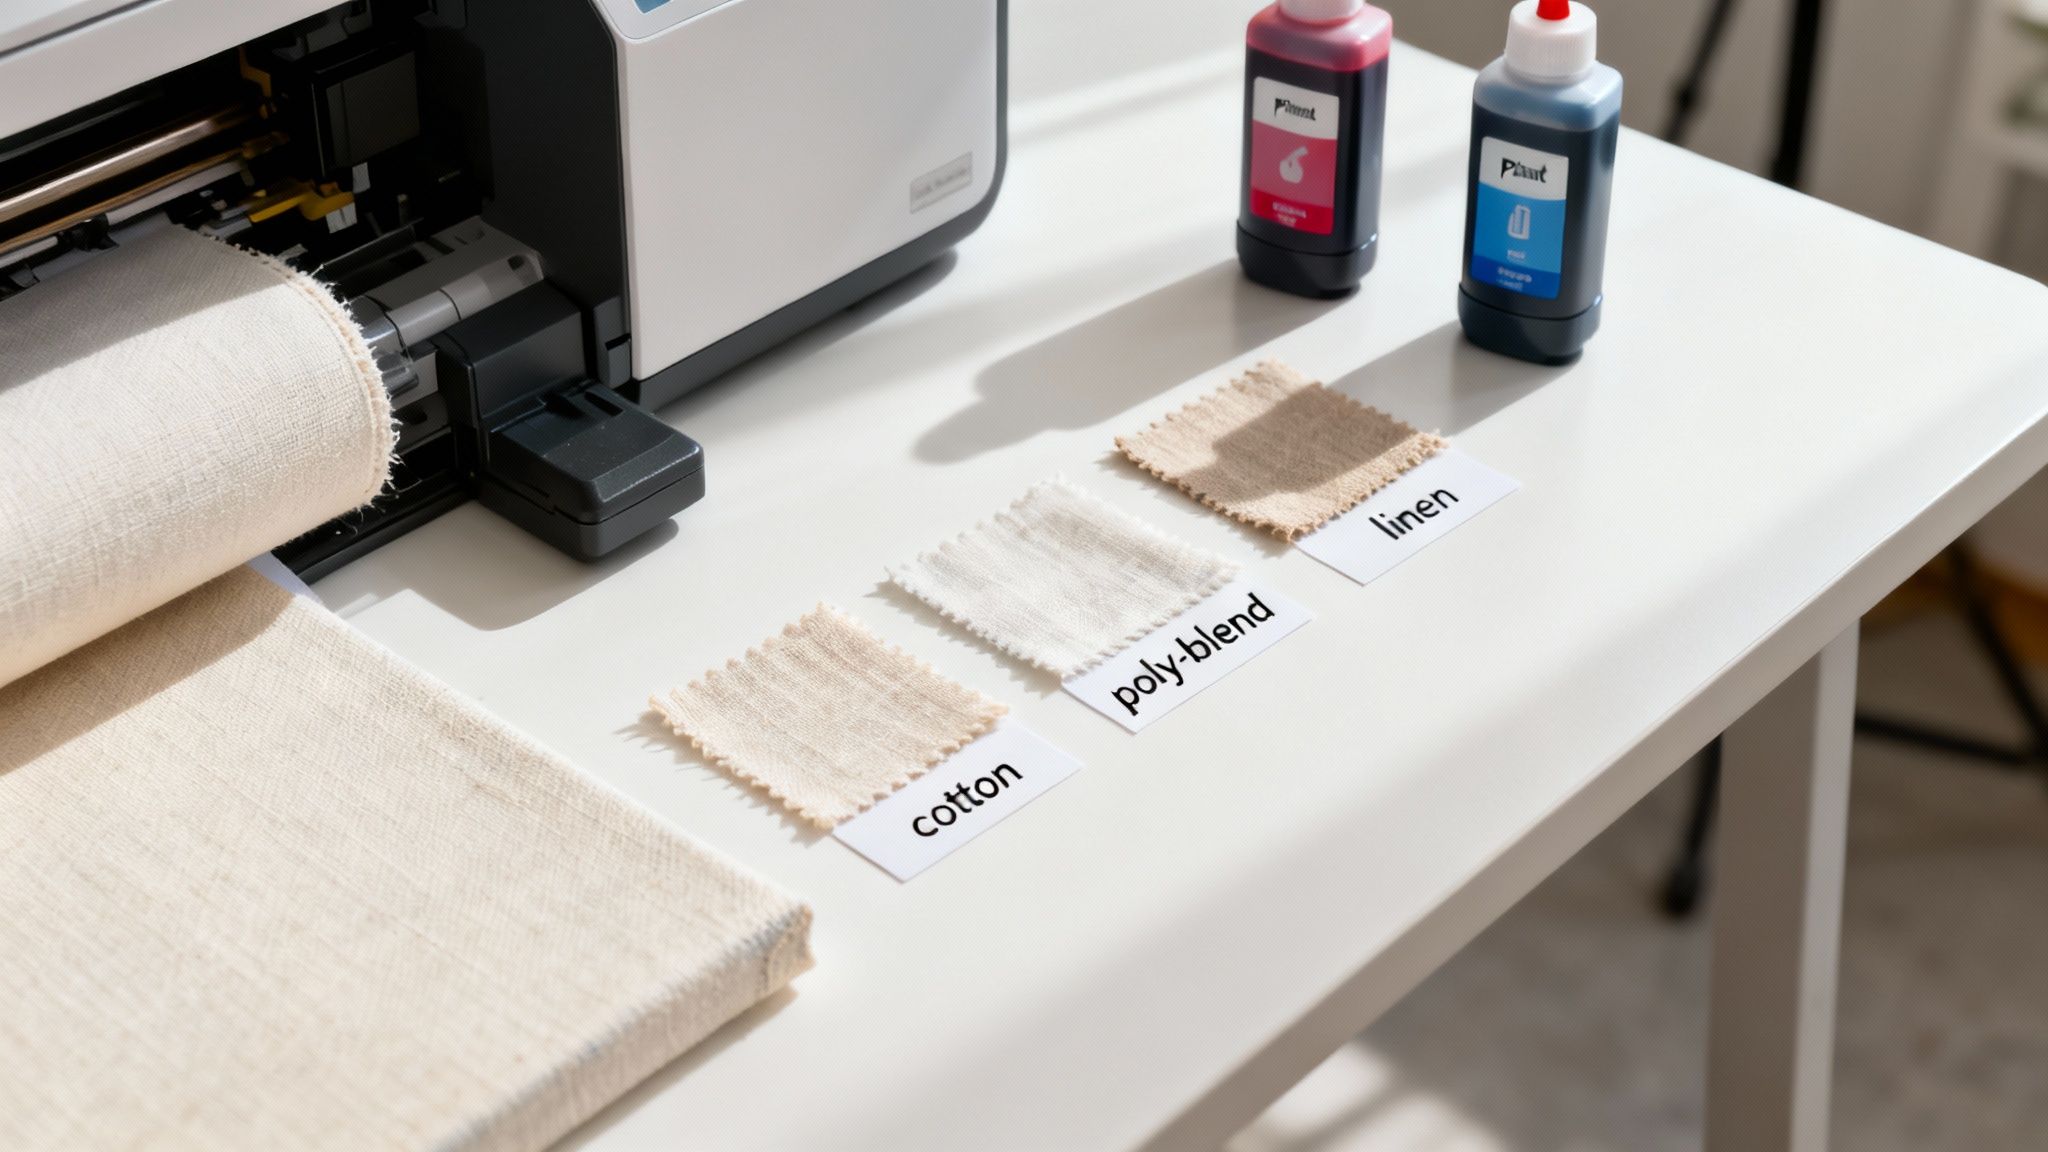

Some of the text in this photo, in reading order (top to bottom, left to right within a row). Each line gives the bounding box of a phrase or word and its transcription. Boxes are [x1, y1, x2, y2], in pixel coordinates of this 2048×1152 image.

[1368, 484, 1459, 541] linen
[1110, 592, 1275, 716] poly-blend
[912, 762, 1023, 838] cotton
